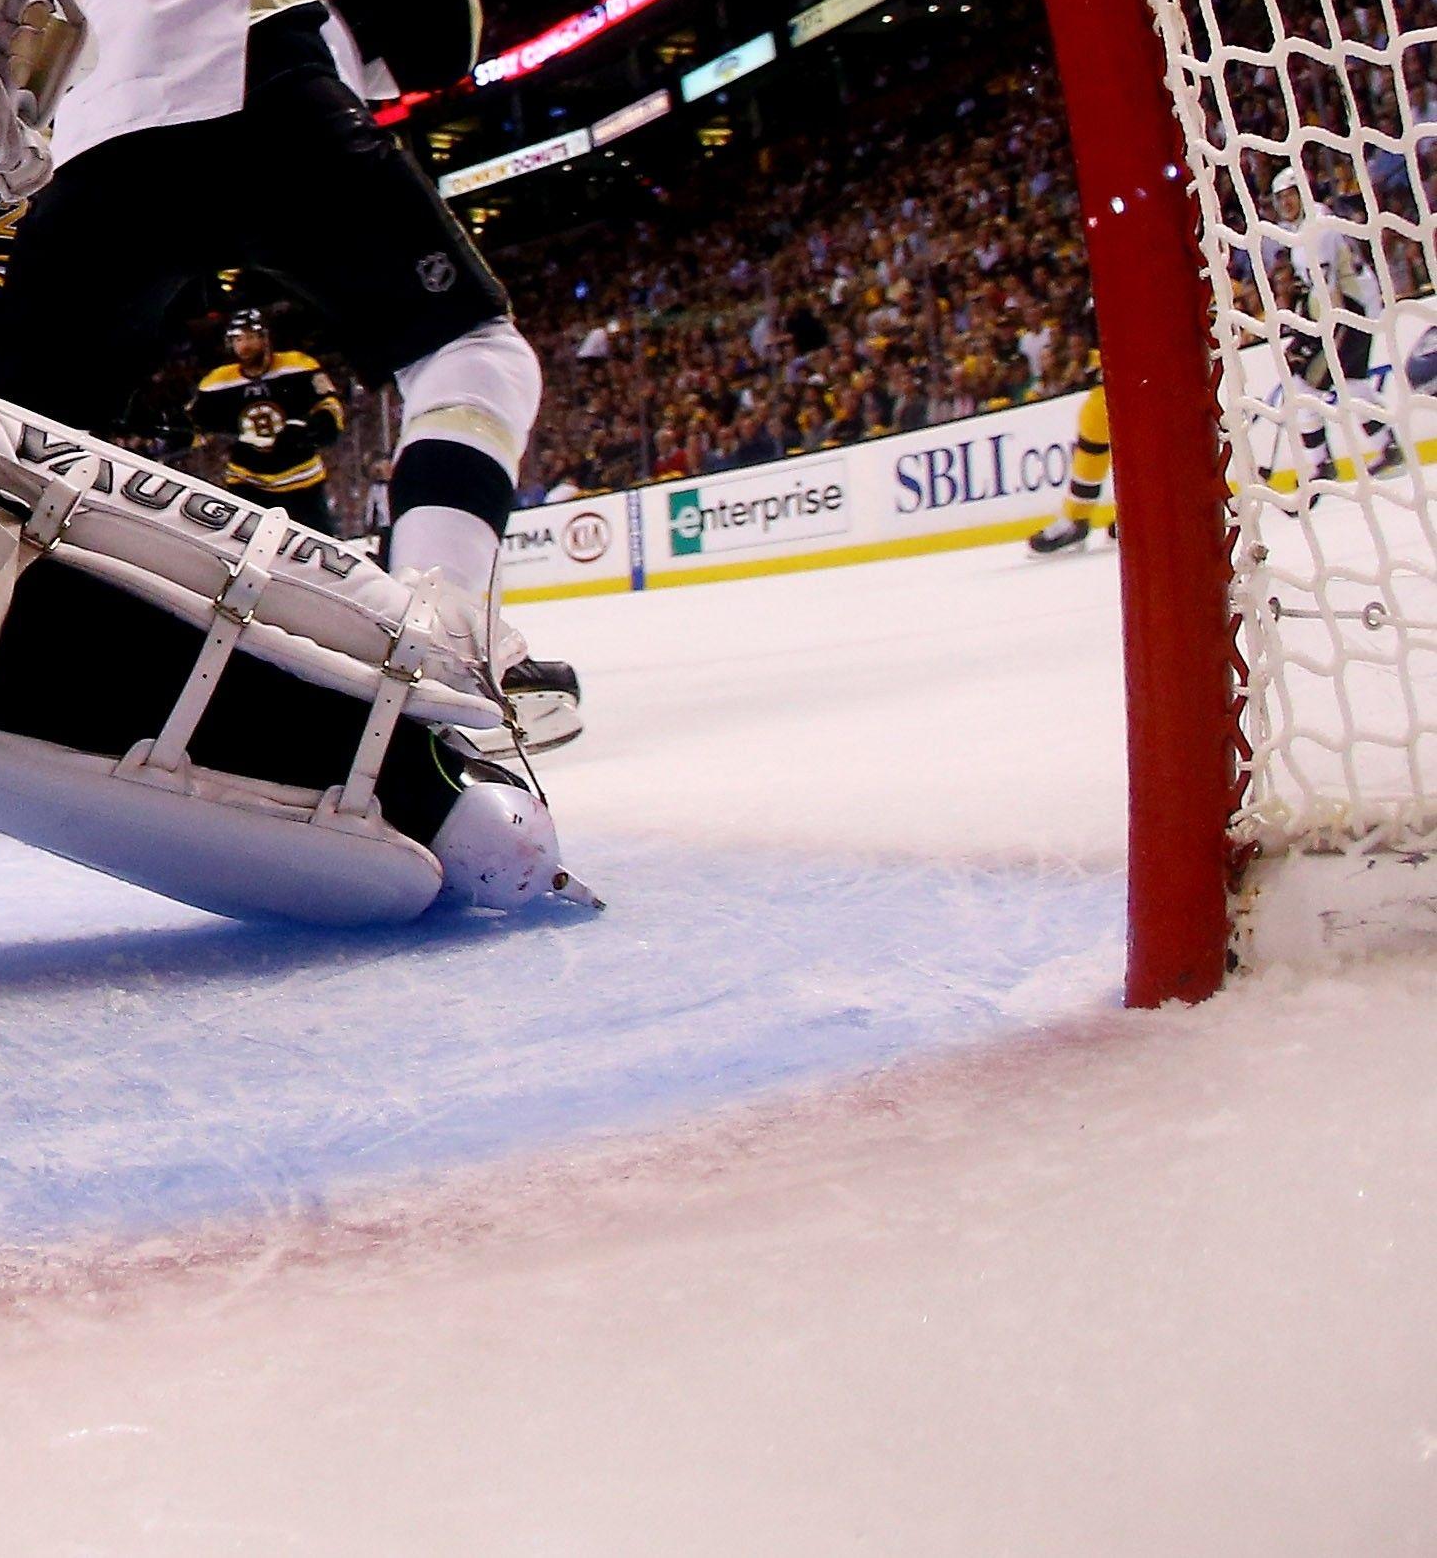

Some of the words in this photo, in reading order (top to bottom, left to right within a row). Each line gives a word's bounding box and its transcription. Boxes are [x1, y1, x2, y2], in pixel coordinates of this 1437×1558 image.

[894, 432, 1076, 517] SBLI.co
[501, 527, 554, 551] TIMA
[678, 480, 843, 540] enterprise
